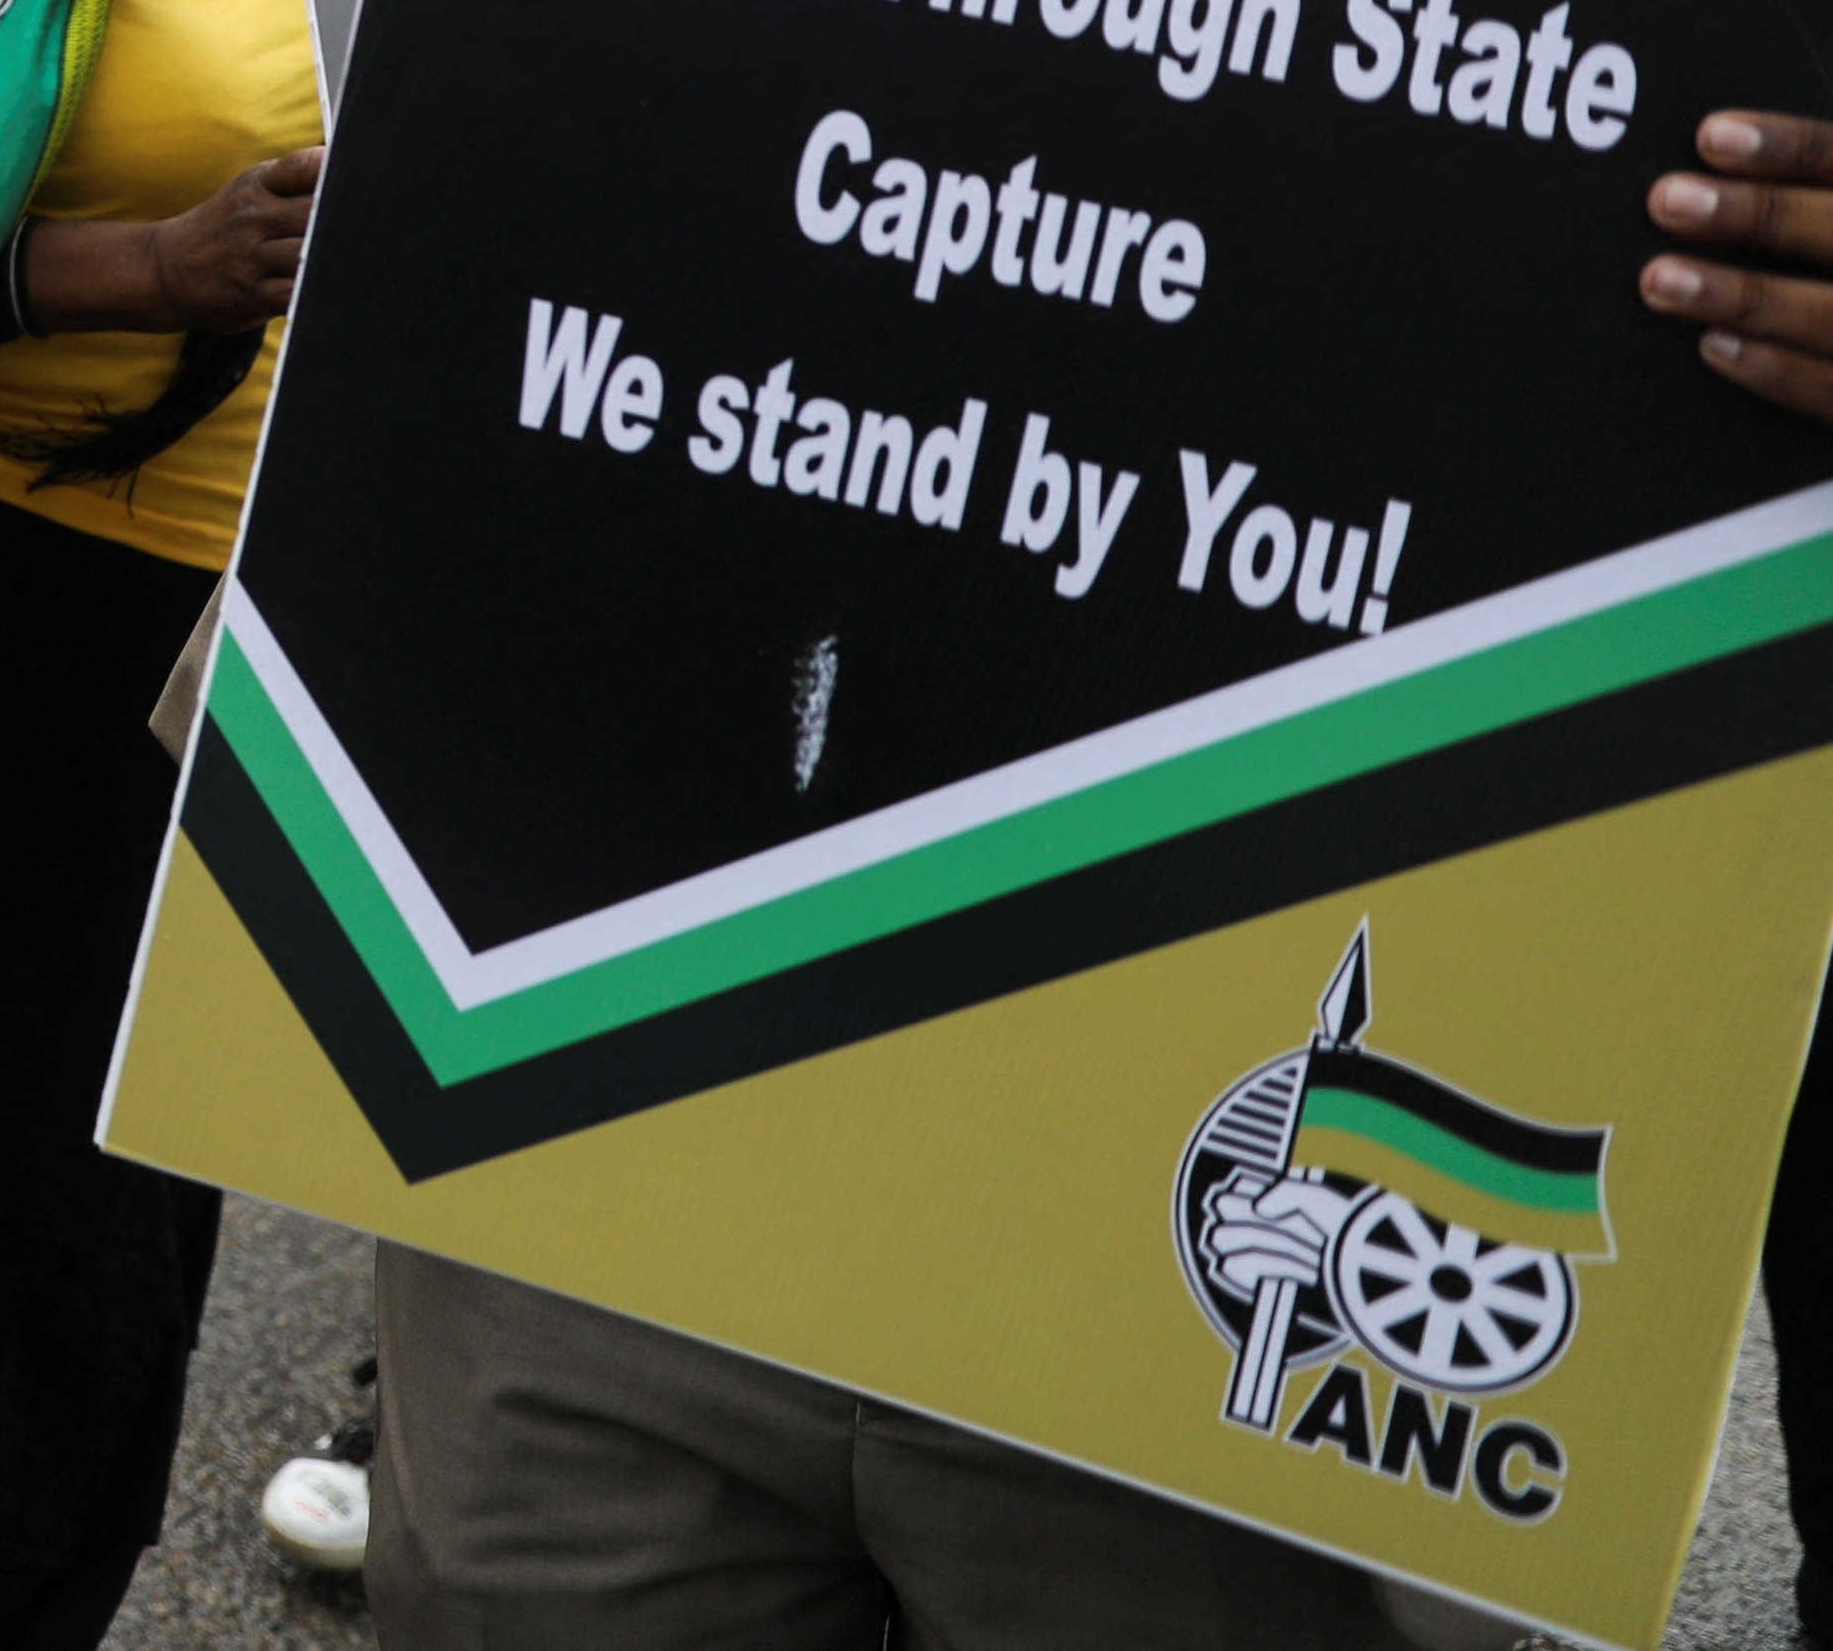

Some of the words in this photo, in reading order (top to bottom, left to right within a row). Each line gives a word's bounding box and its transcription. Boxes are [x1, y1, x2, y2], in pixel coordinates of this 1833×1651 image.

[797, 112, 1205, 320] Capture
[521, 300, 662, 451] We
[690, 361, 986, 528] stand
[1002, 415, 1138, 596] by
[1180, 451, 1410, 633] You!
[1297, 1369, 1563, 1521] ANC
